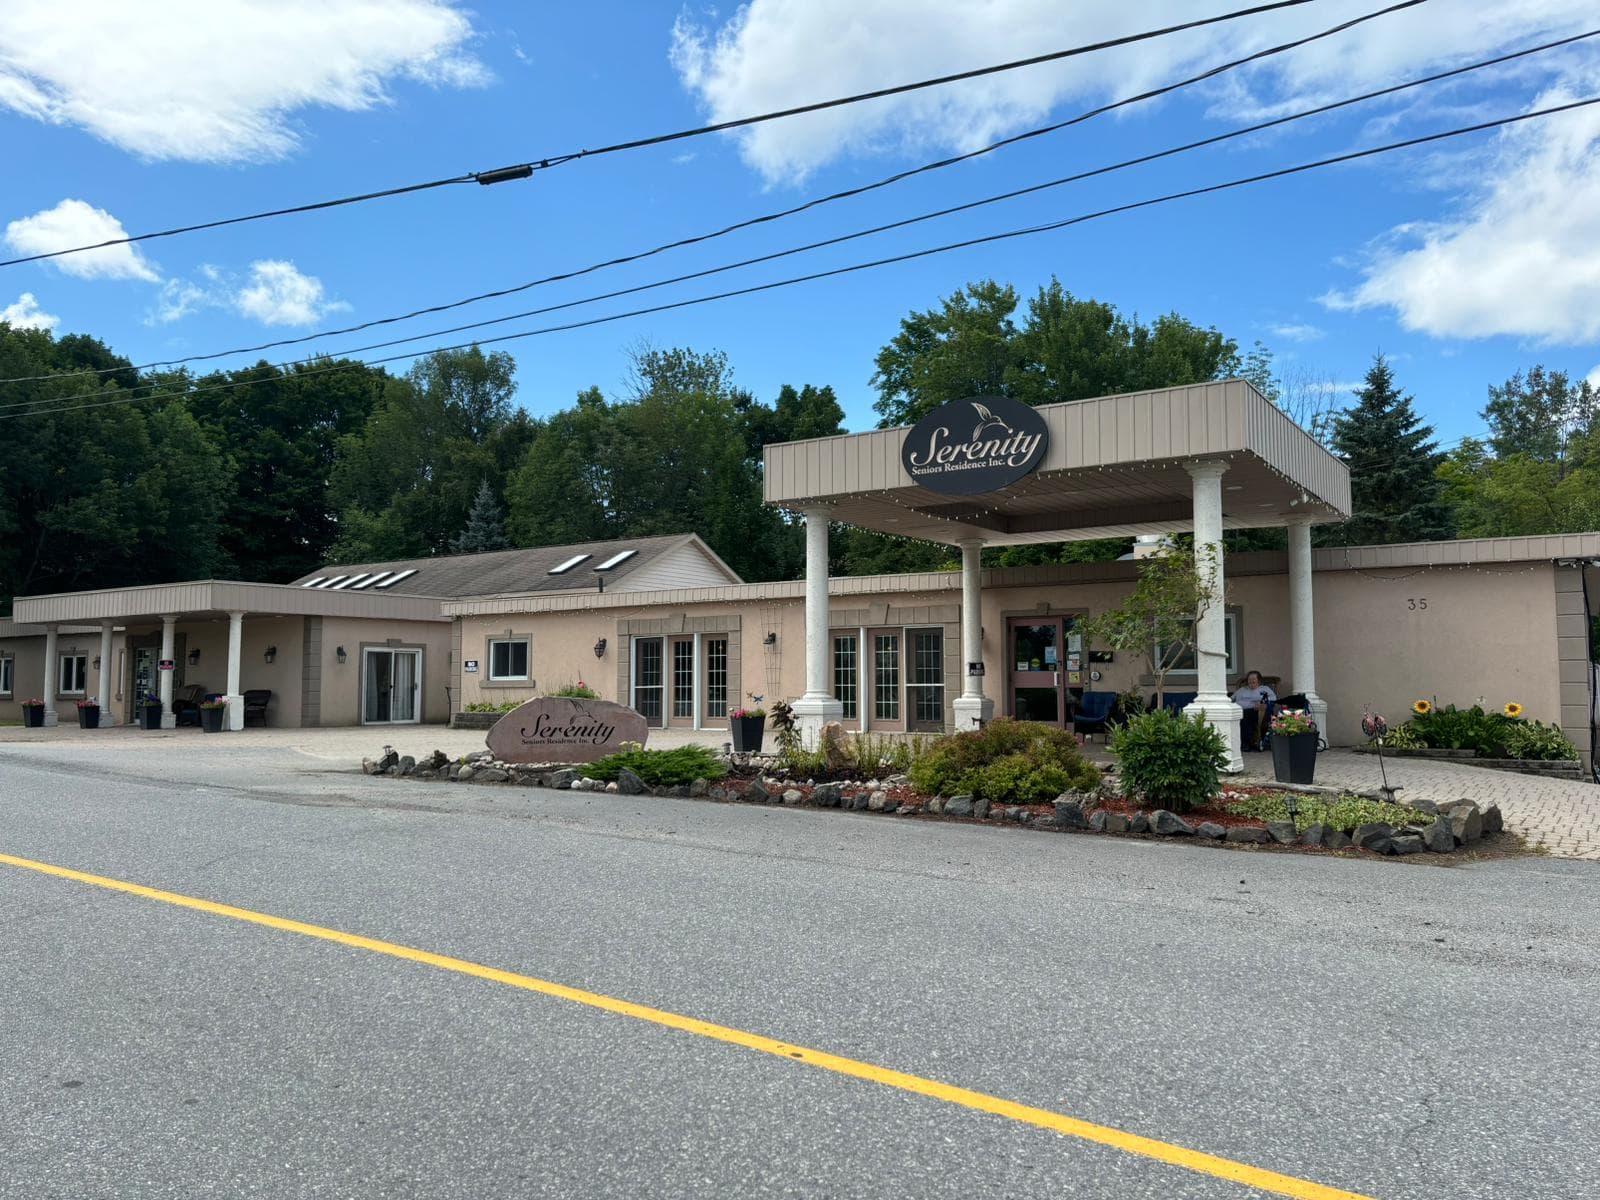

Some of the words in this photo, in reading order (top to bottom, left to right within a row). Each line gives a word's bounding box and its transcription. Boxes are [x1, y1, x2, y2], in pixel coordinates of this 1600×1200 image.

[910, 426, 1042, 467] Serenity
[911, 465, 942, 476] Seniors
[944, 460, 987, 472] Residence
[988, 457, 1006, 467] Inc.
[1407, 598, 1428, 610] 35
[520, 713, 616, 745] Serenity
